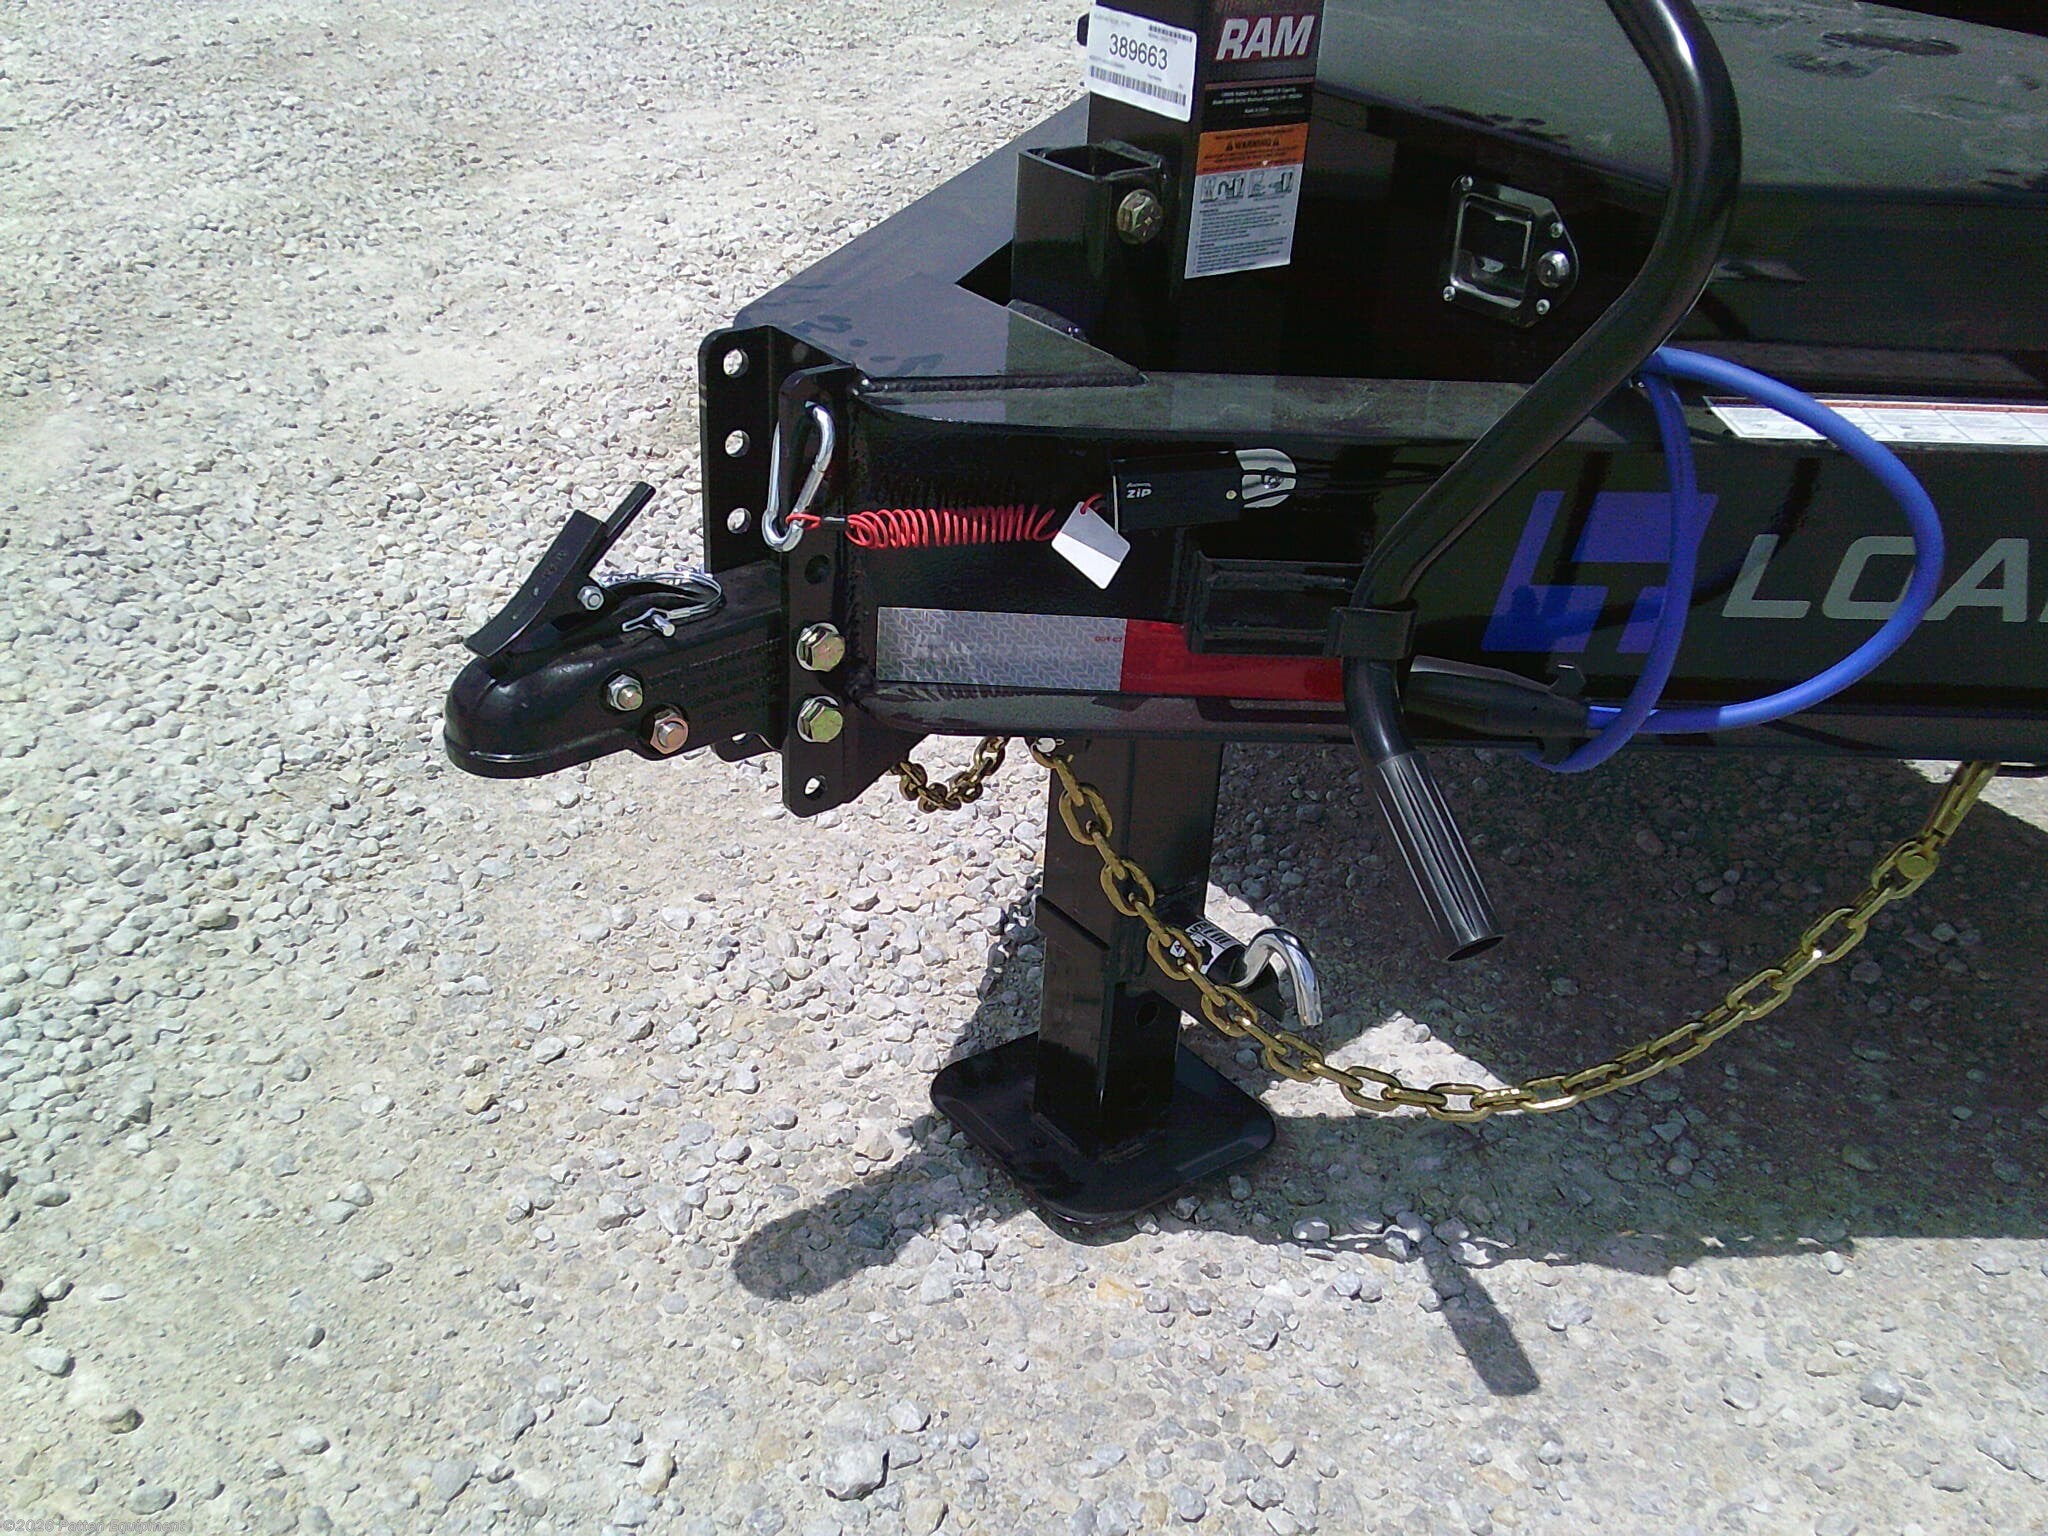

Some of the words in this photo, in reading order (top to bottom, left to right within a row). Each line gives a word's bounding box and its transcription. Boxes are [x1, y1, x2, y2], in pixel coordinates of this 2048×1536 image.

[1109, 33, 1168, 70] 389663
[1216, 15, 1315, 60] RAM
[1722, 533, 2048, 622] LOA
